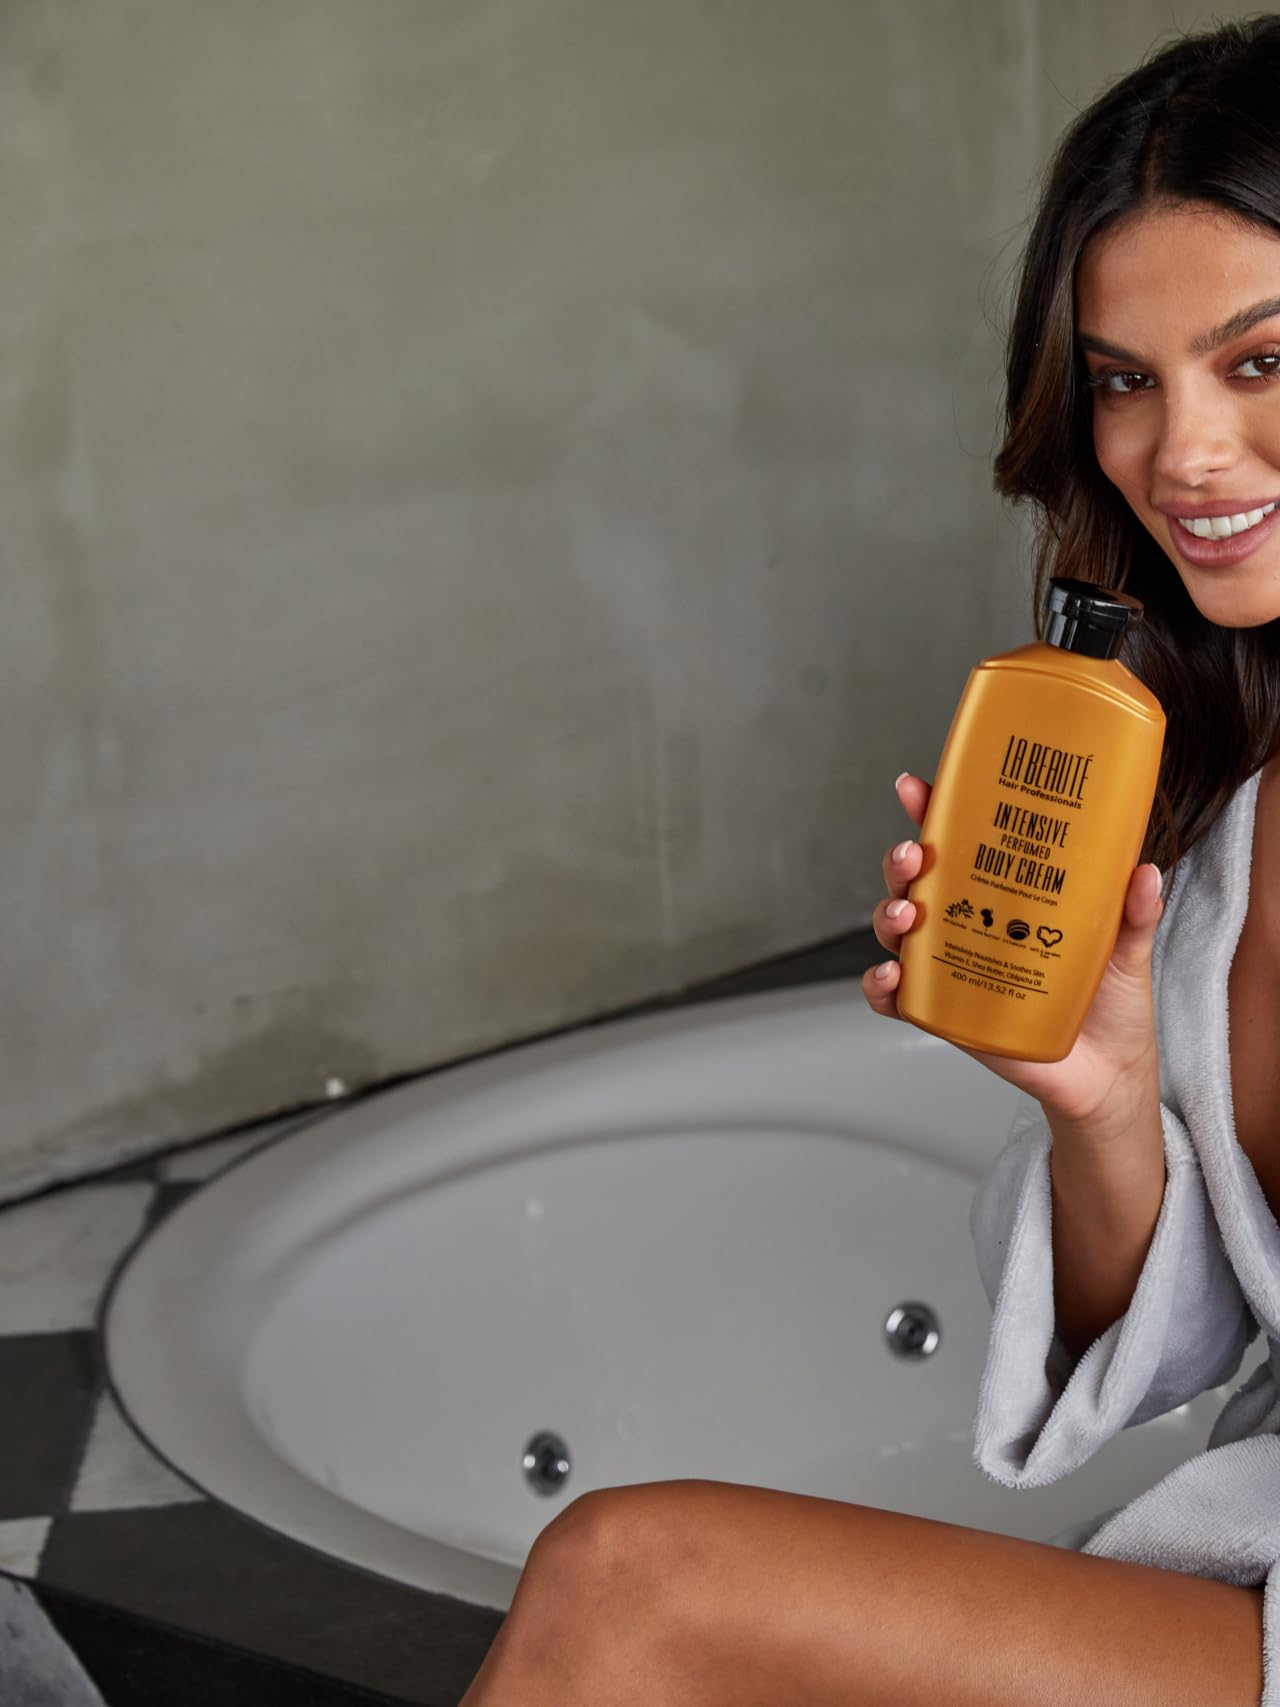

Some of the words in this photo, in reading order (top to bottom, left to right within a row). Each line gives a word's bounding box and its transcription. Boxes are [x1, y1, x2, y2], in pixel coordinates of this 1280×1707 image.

[1001, 735, 1028, 781] LA
[1023, 742, 1094, 801] BEAUTÉ
[998, 777, 1019, 791] Hair
[1020, 785, 1082, 809] Professionals
[993, 801, 1071, 848] INTENSIVE
[1000, 833, 1051, 860] PERFUMED
[974, 843, 1016, 880] BODY
[1015, 857, 1066, 895] CREAM
[1018, 888, 1033, 899] Pour
[1033, 894, 1041, 902] Le
[1041, 896, 1058, 907] Corps
[951, 971, 967, 982] 400
[968, 977, 1007, 996] ml/13.52
[1008, 988, 1015, 997] fl
[1015, 992, 1027, 1000] oz
